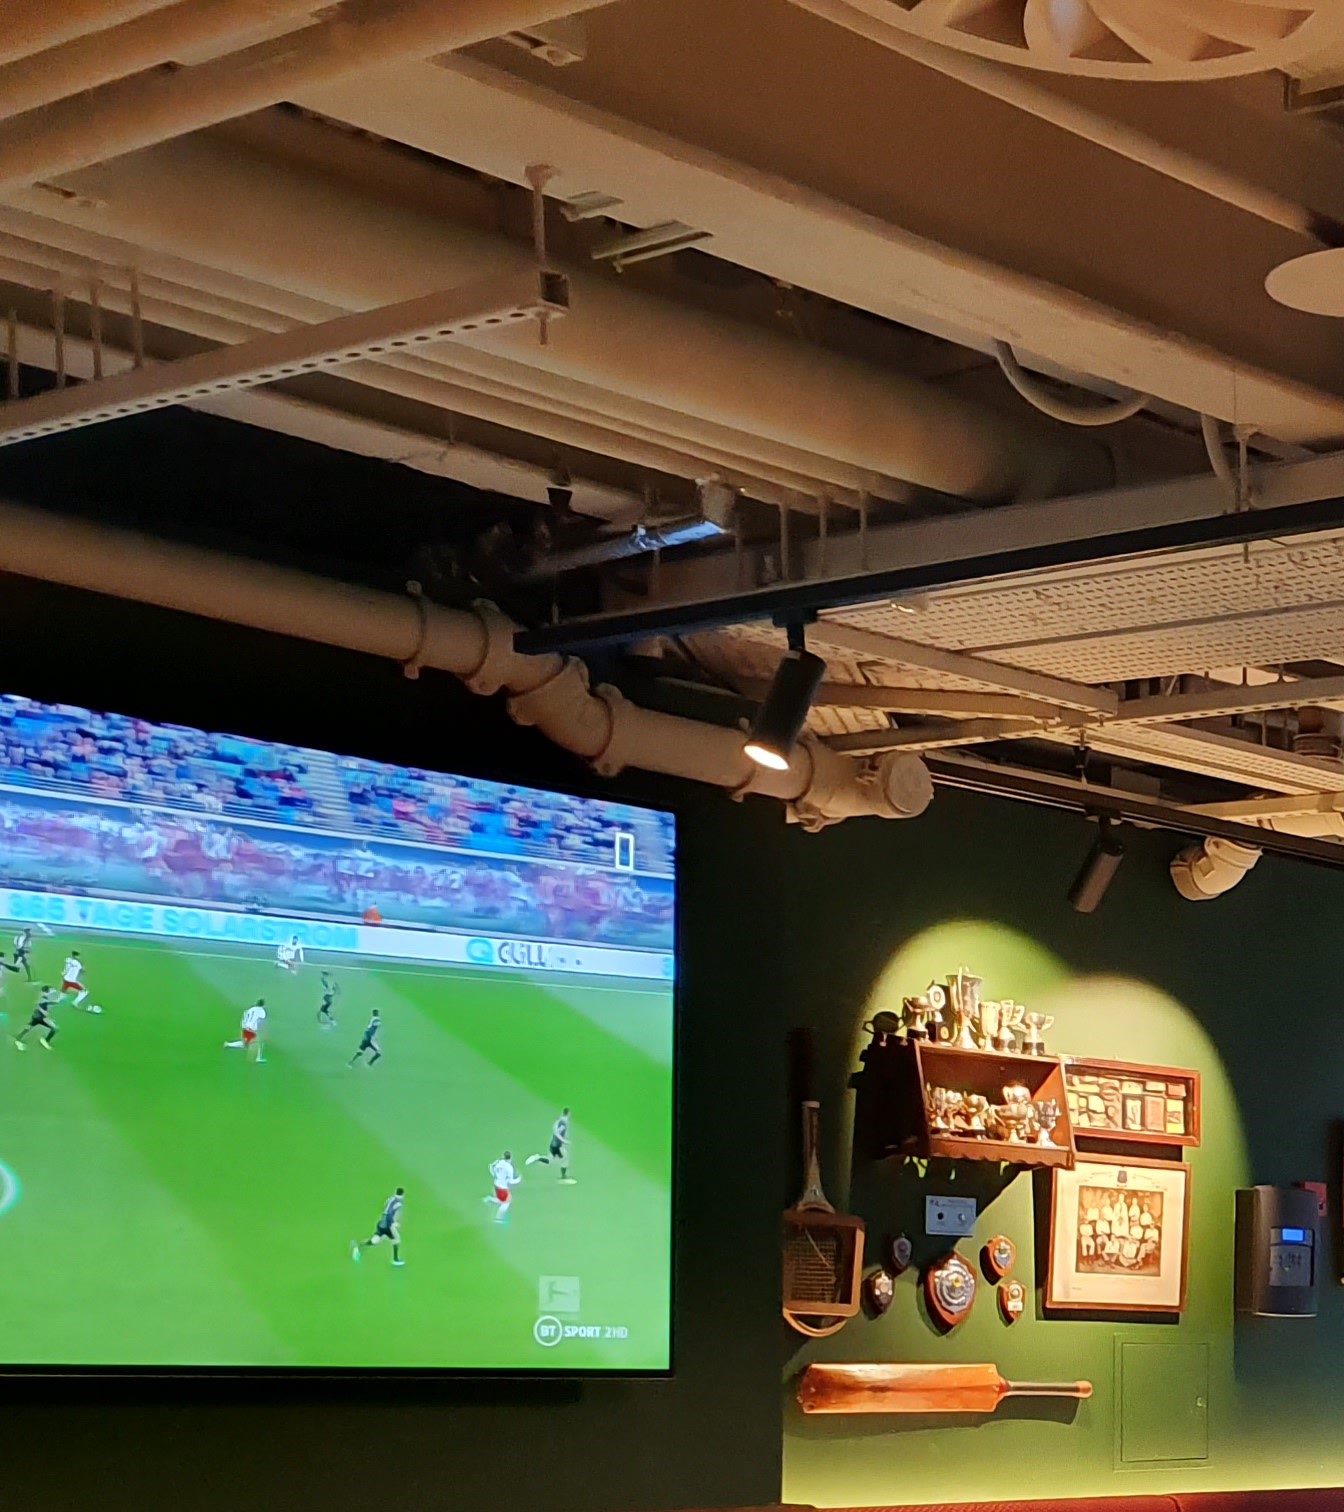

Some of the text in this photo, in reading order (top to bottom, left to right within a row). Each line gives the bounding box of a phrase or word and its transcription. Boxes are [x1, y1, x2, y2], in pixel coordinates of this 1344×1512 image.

[76, 898, 155, 930] TAGE
[540, 1324, 557, 1337] BT
[564, 1325, 602, 1338] SPORT
